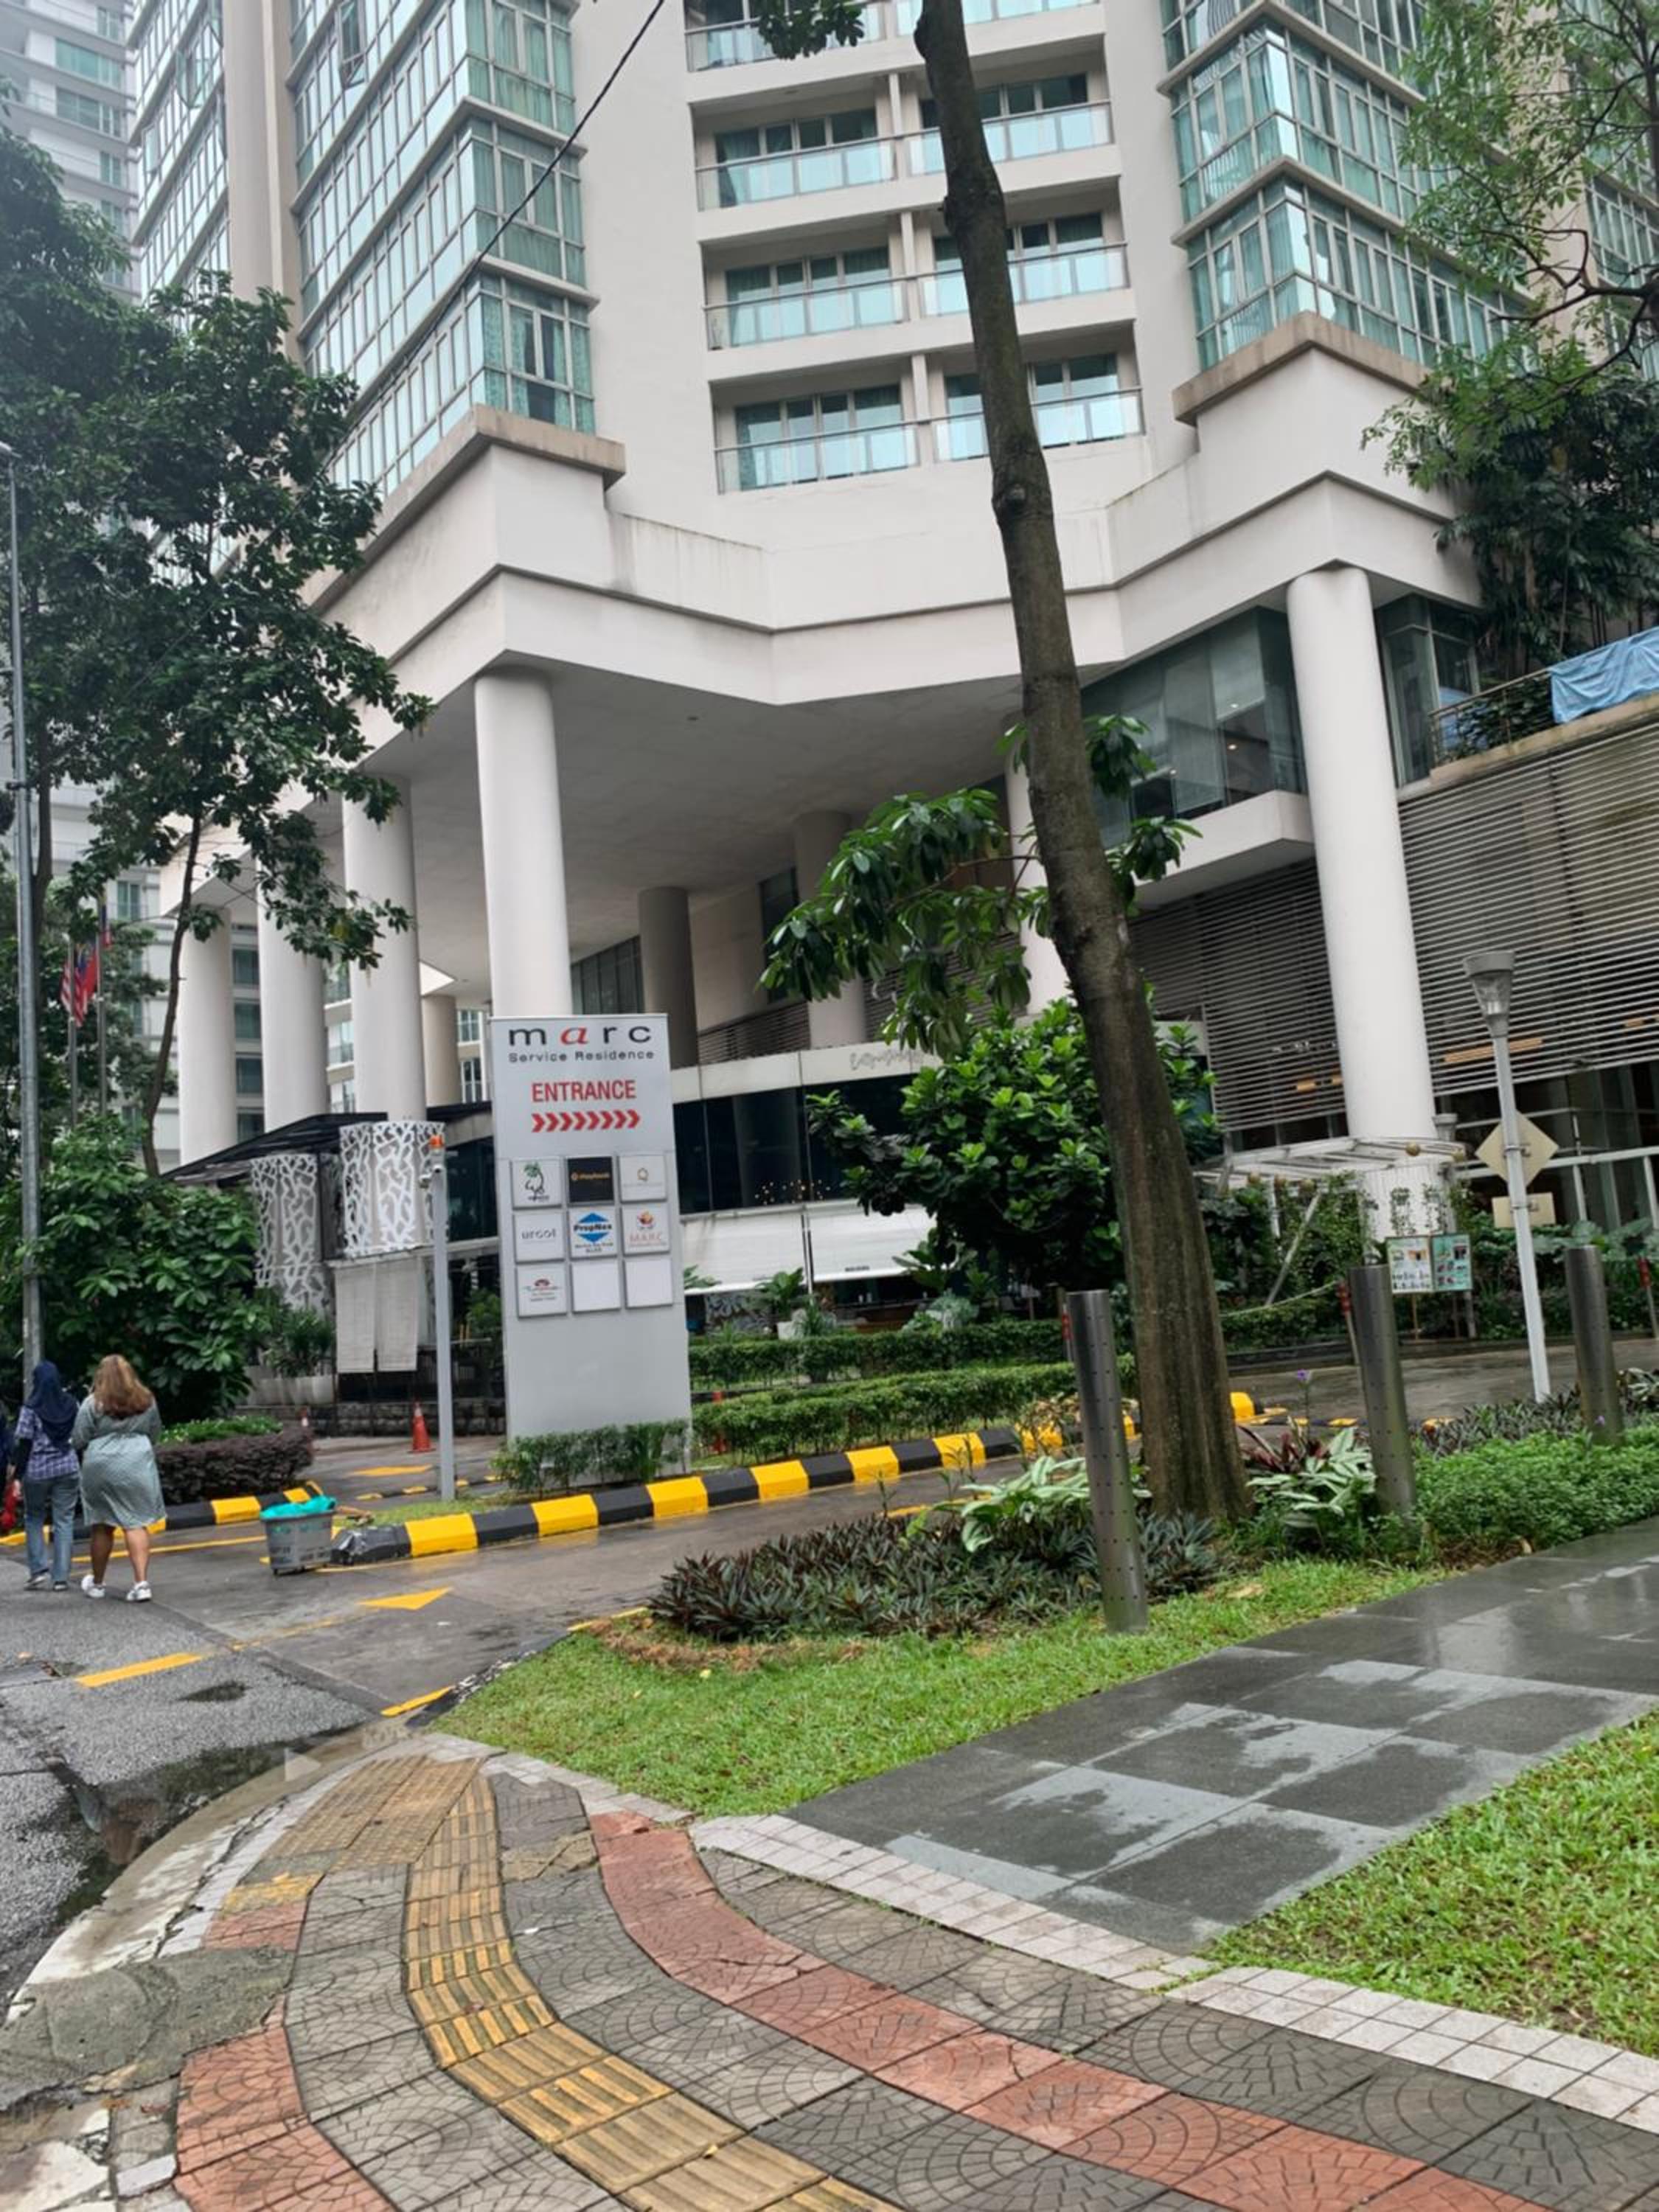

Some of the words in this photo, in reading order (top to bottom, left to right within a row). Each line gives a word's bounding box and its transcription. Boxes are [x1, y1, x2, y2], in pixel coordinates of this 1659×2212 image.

[509, 1026, 652, 1047] marc
[509, 1052, 568, 1063] Service
[574, 1050, 655, 1062] Residence
[532, 1079, 637, 1103] ENTRANCE
